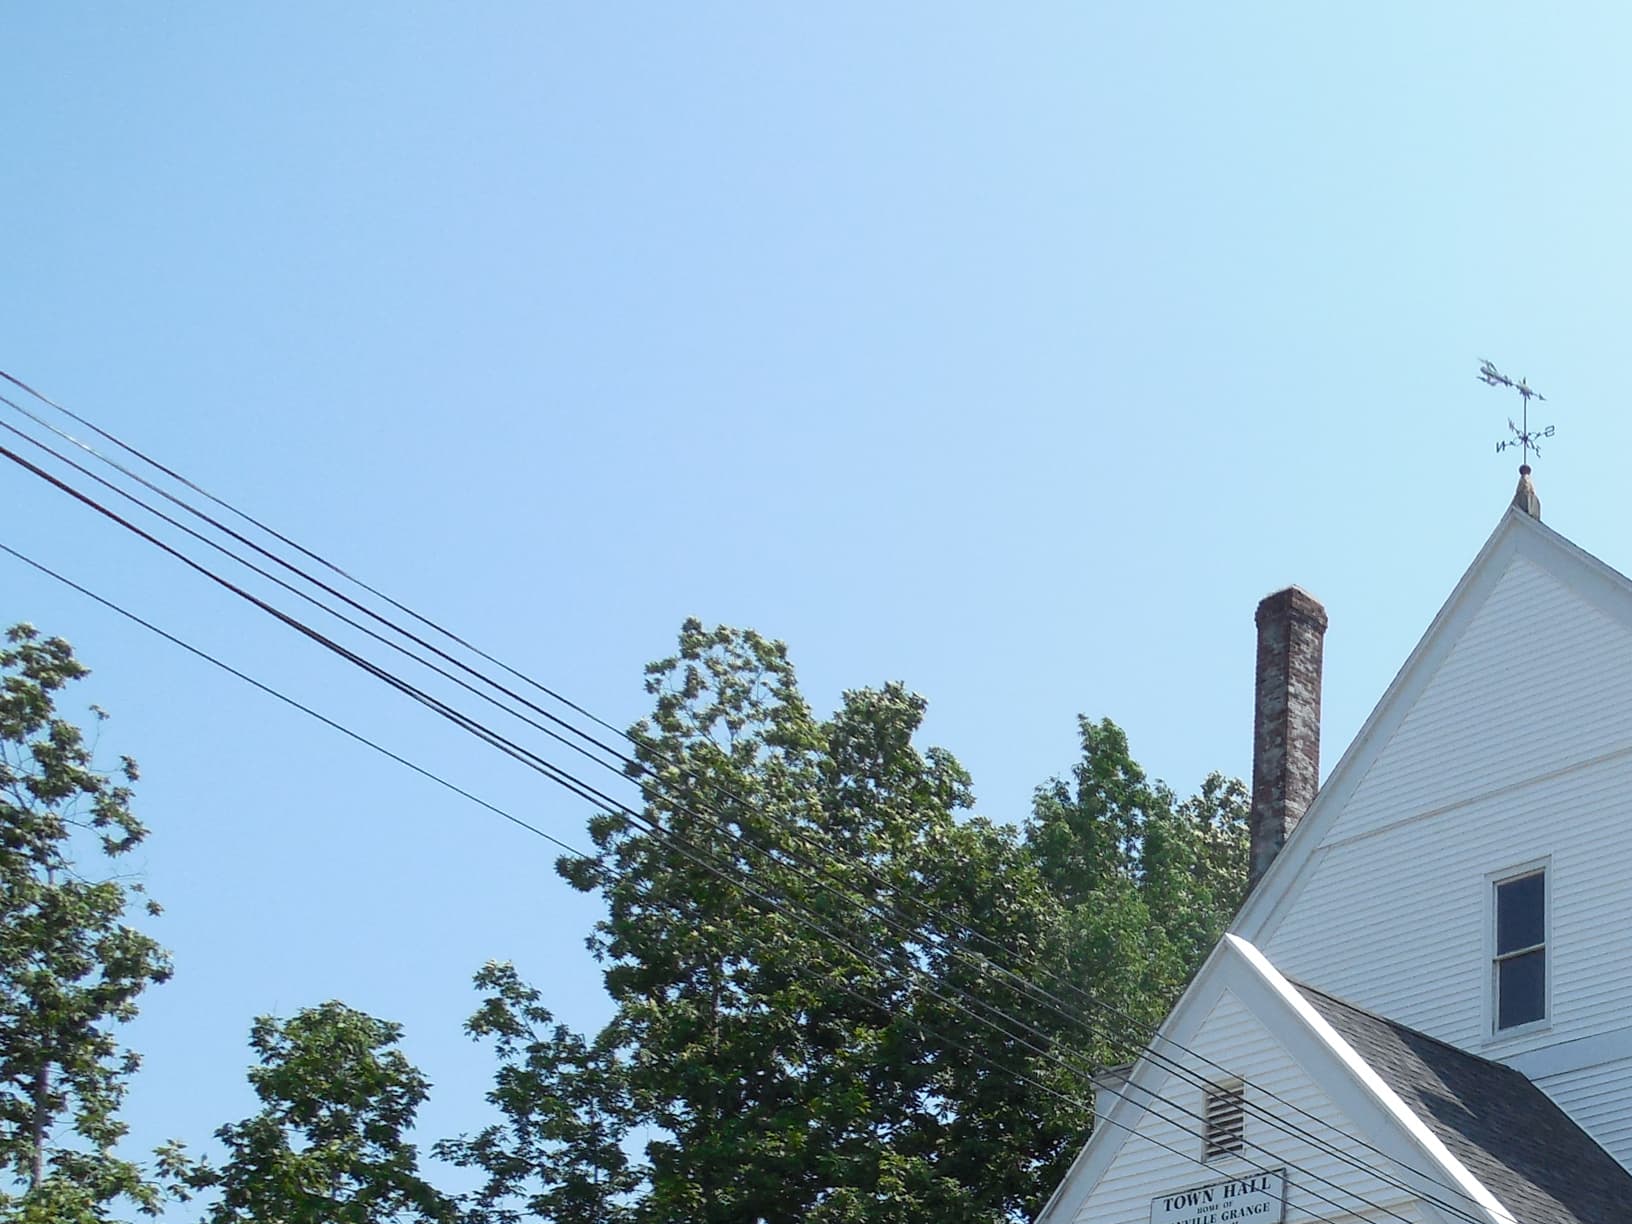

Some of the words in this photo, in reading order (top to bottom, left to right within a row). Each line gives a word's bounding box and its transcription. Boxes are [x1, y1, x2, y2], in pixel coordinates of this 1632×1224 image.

[1163, 1188, 1214, 1212] TOWN
[1223, 1176, 1271, 1199] HALL
[1197, 1204, 1219, 1214] HOME
[1223, 1201, 1232, 1209] OF
[1221, 1202, 1271, 1222] GRANGE
